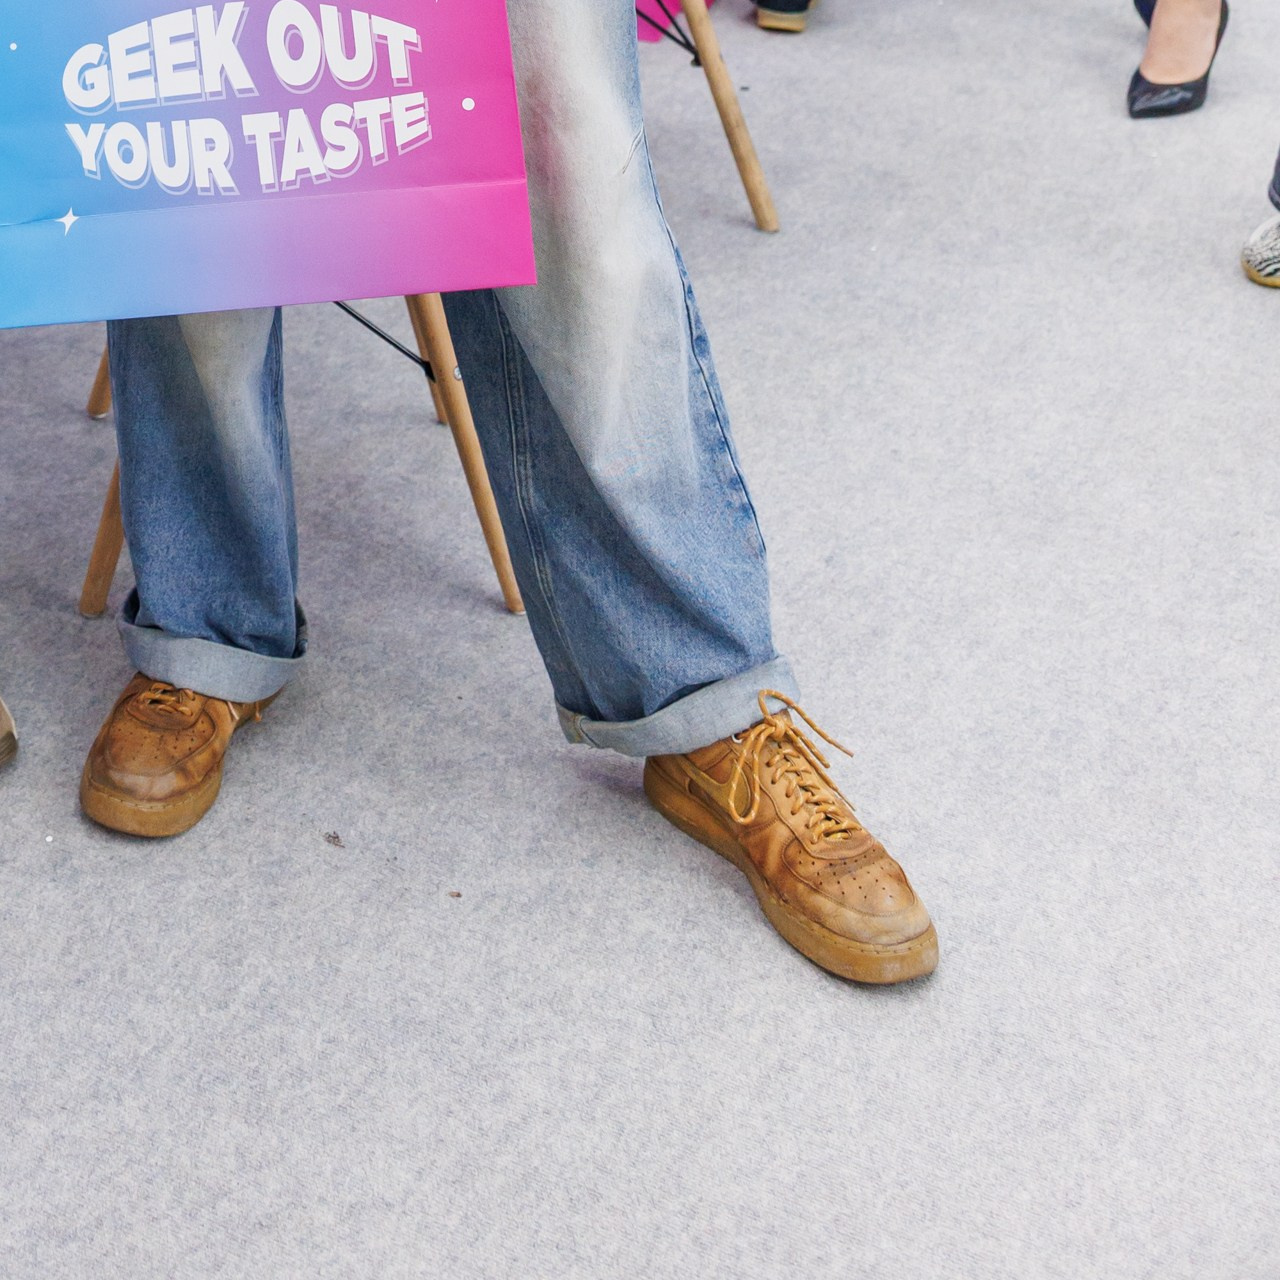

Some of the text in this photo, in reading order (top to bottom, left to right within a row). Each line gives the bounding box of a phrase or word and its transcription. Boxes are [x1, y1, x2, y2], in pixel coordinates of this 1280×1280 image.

[62, 0, 259, 116] GEEK
[65, 90, 432, 196] YOUR TASTE
